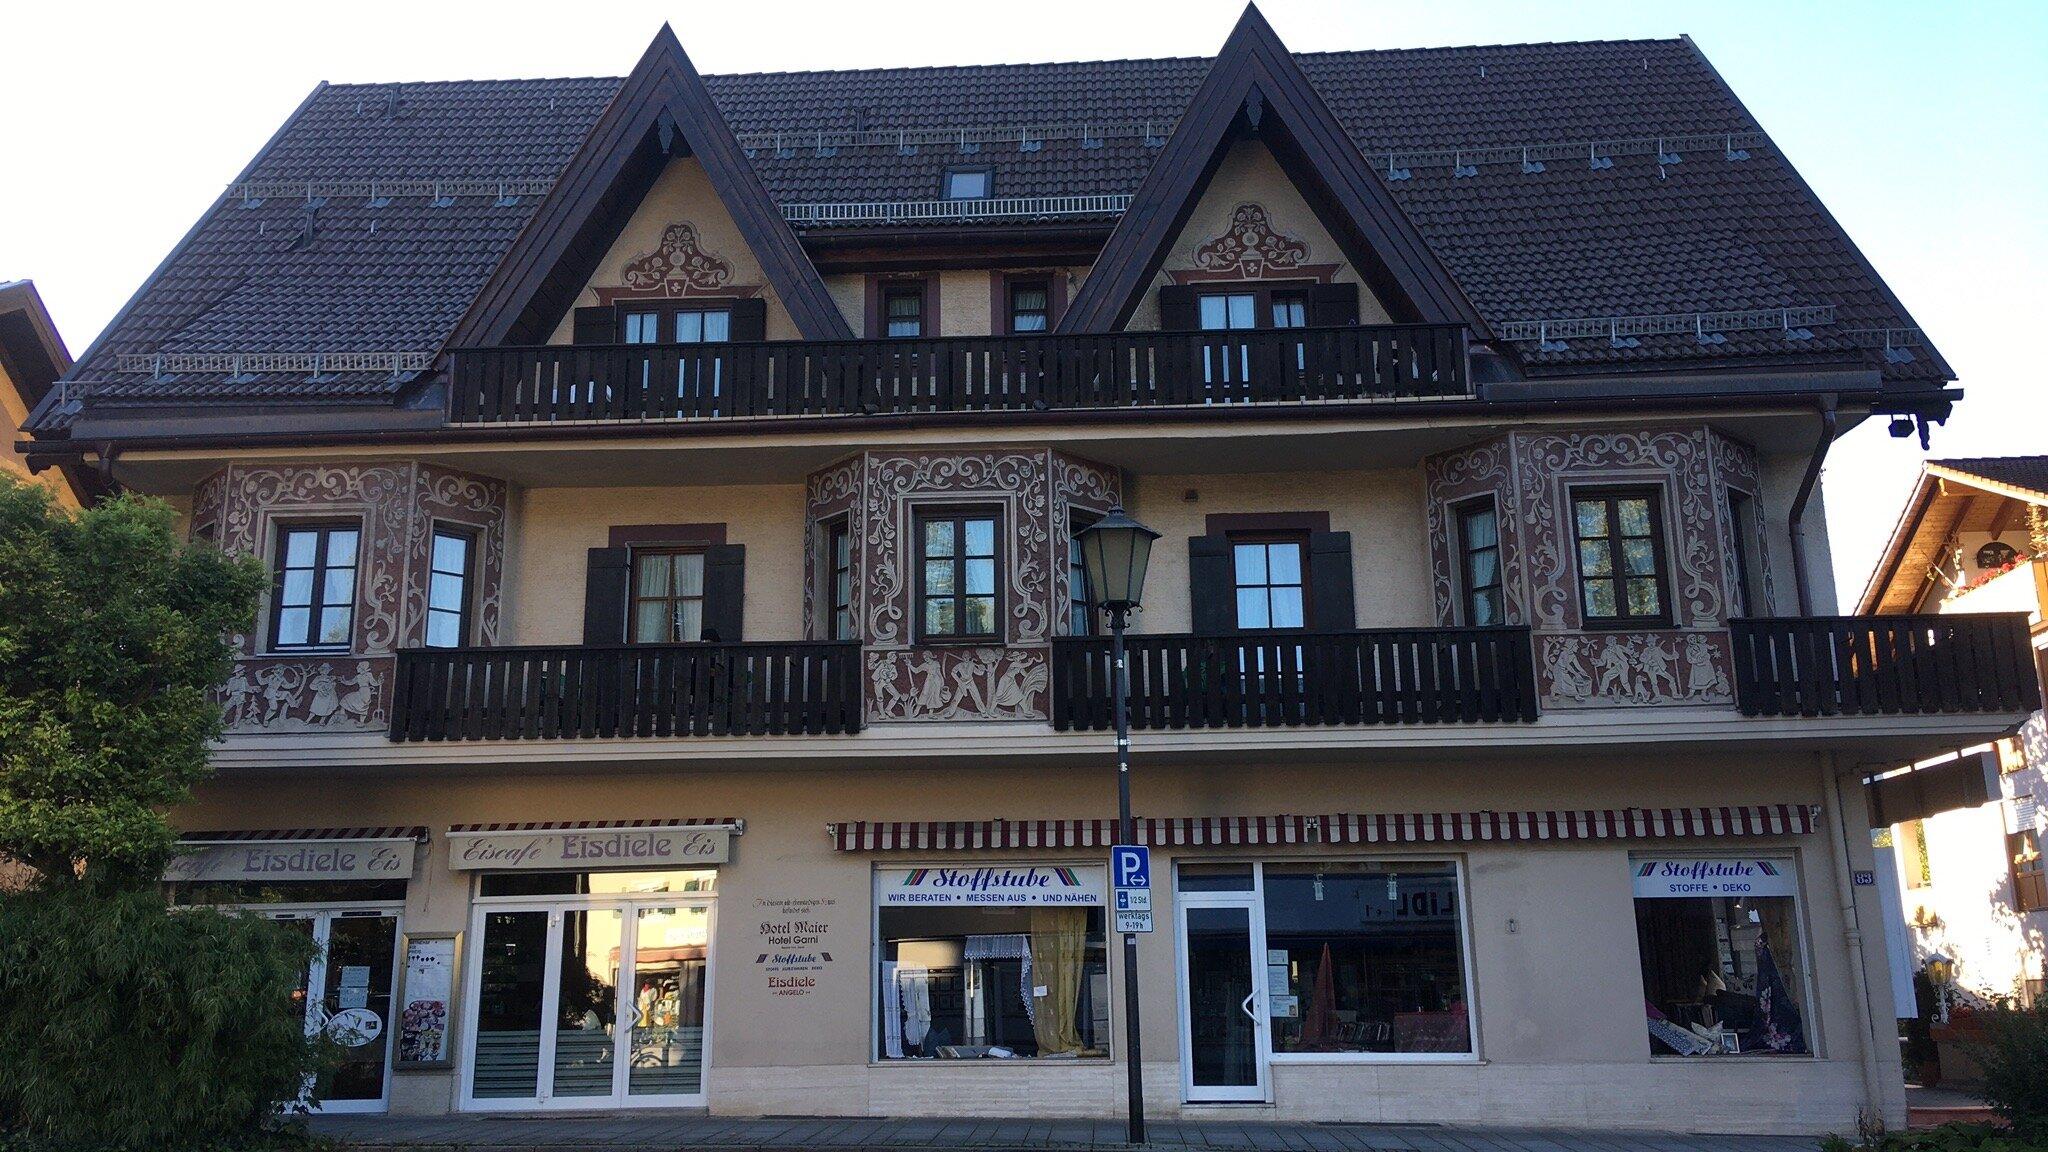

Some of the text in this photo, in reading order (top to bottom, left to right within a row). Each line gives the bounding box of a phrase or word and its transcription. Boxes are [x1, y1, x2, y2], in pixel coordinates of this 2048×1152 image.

[560, 834, 671, 860] Eisdiele
[683, 833, 717, 857] Eis
[242, 848, 356, 873] Eisdiele
[367, 848, 402, 872] Eis
[1121, 852, 1141, 886] P
[1660, 861, 1755, 879] Stoffstube
[932, 867, 1051, 891] Stoffstube
[1856, 873, 1872, 884] 83
[1669, 884, 1751, 892] STOFFE DEKO
[888, 893, 1097, 902] WIR BERATEN MESSEN AUS UND NÄHEN
[1118, 911, 1150, 921] werktags
[760, 921, 829, 935] Hotel Maier
[768, 935, 819, 945] Hotel Garni
[771, 953, 817, 965] Stoffstube
[768, 976, 816, 988] Eisdiele
